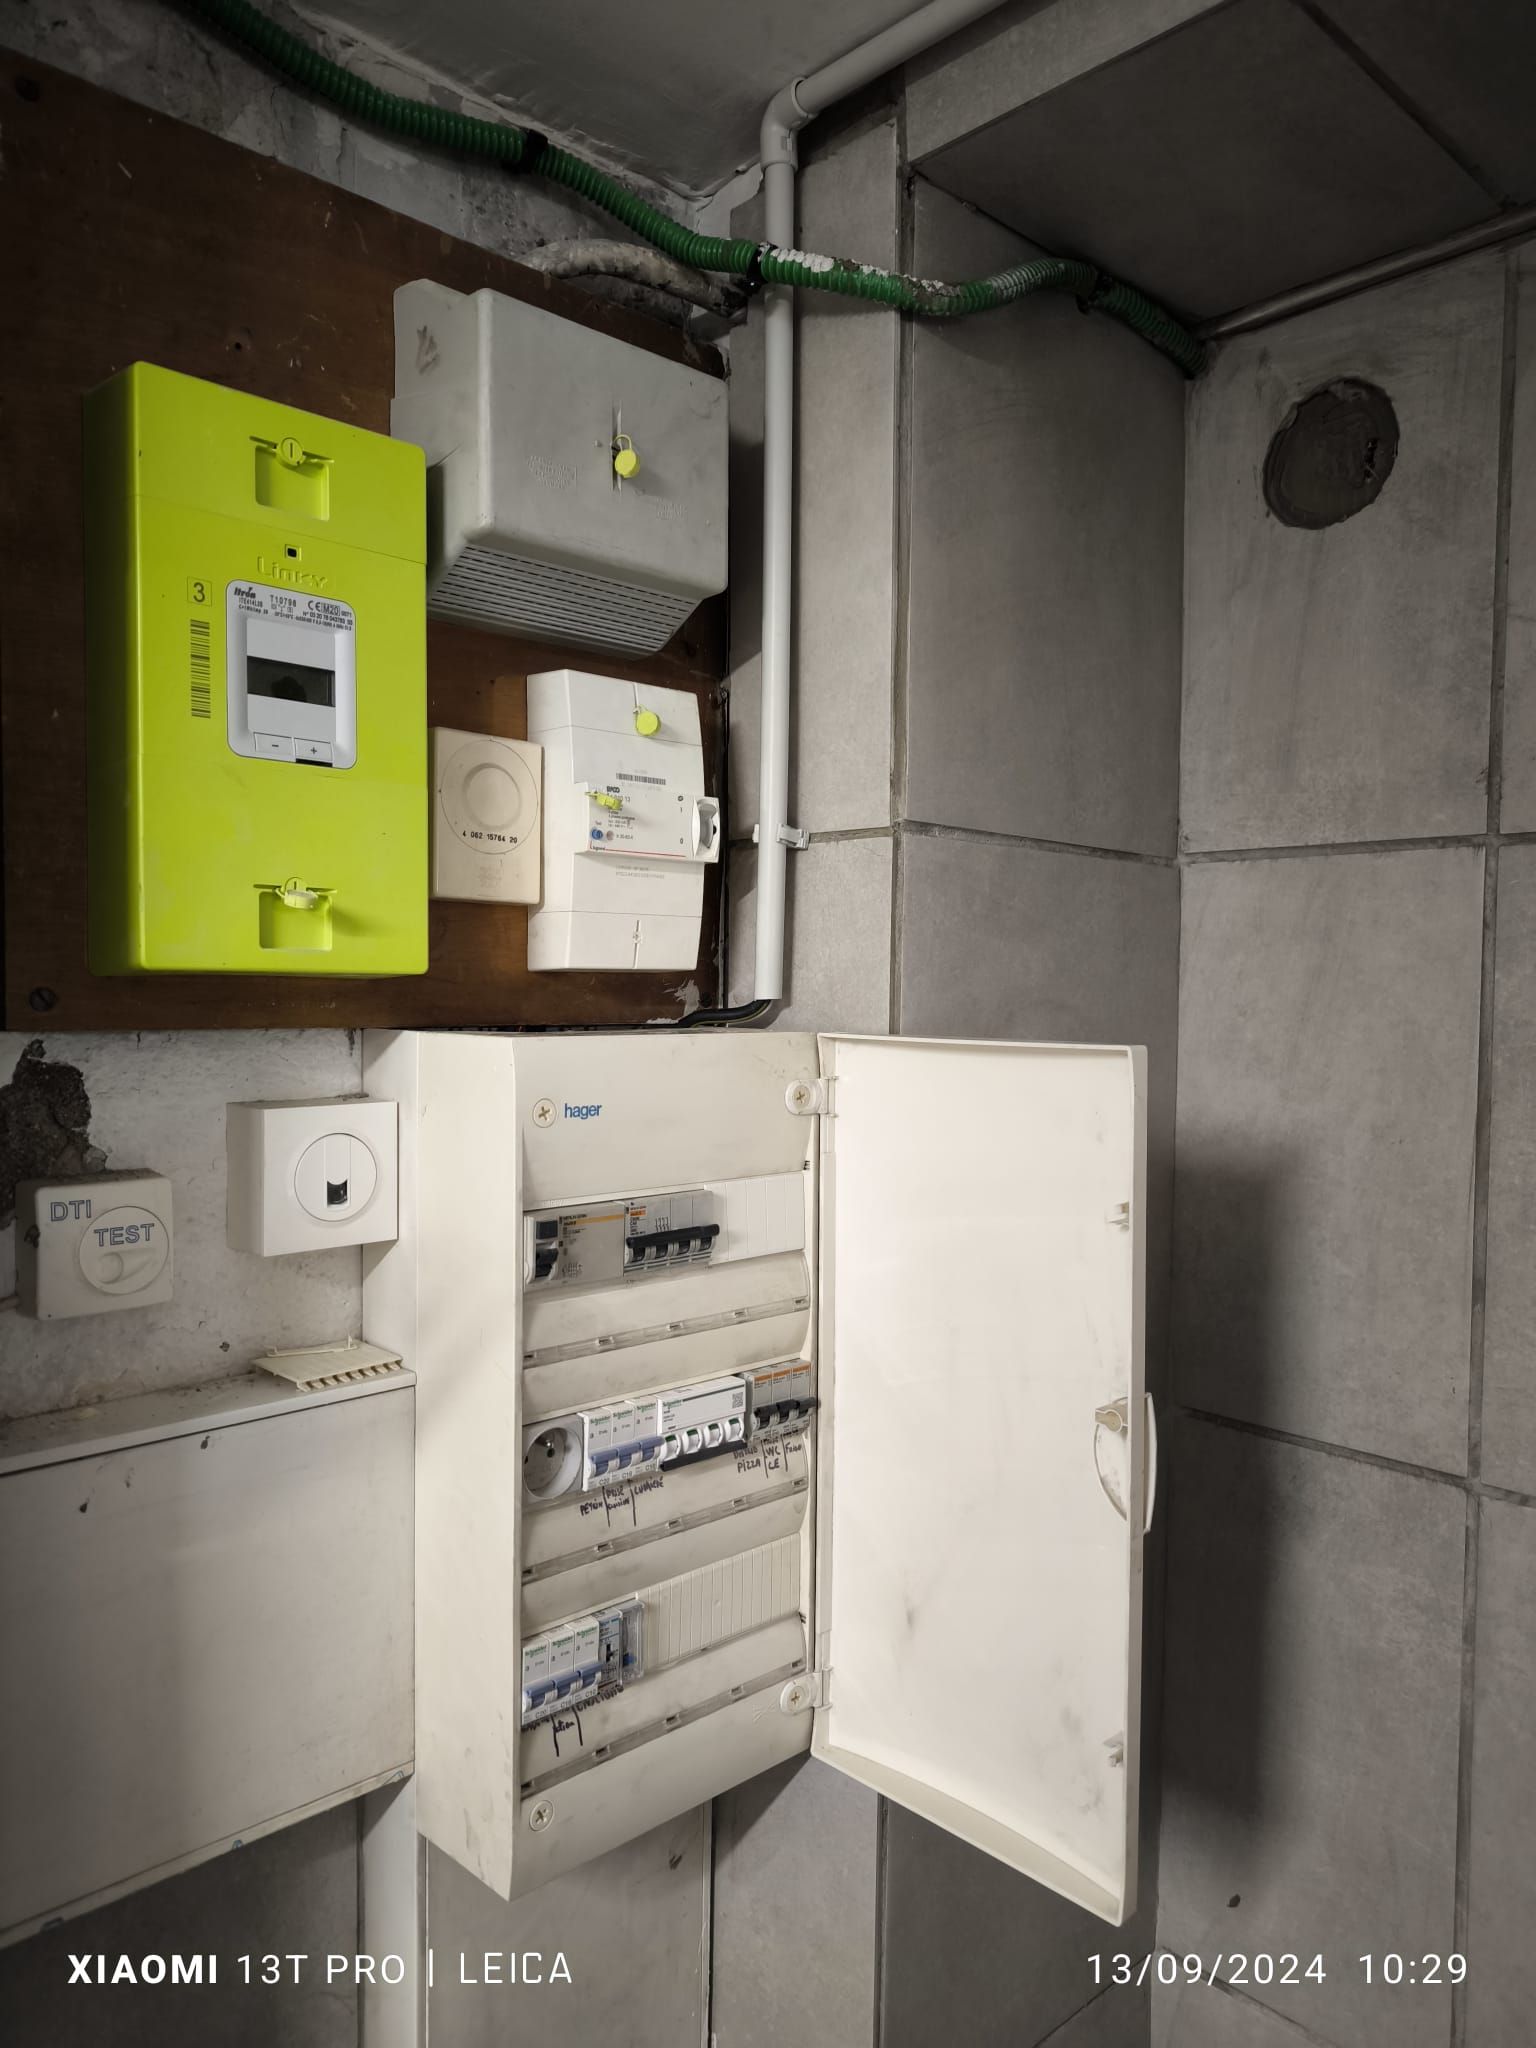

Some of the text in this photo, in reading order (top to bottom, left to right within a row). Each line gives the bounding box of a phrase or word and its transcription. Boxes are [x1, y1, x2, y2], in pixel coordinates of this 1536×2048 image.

[193, 582, 206, 603] 3
[564, 1103, 603, 1120] hager
[50, 1199, 92, 1222] DTI
[94, 1223, 155, 1247] TEST
